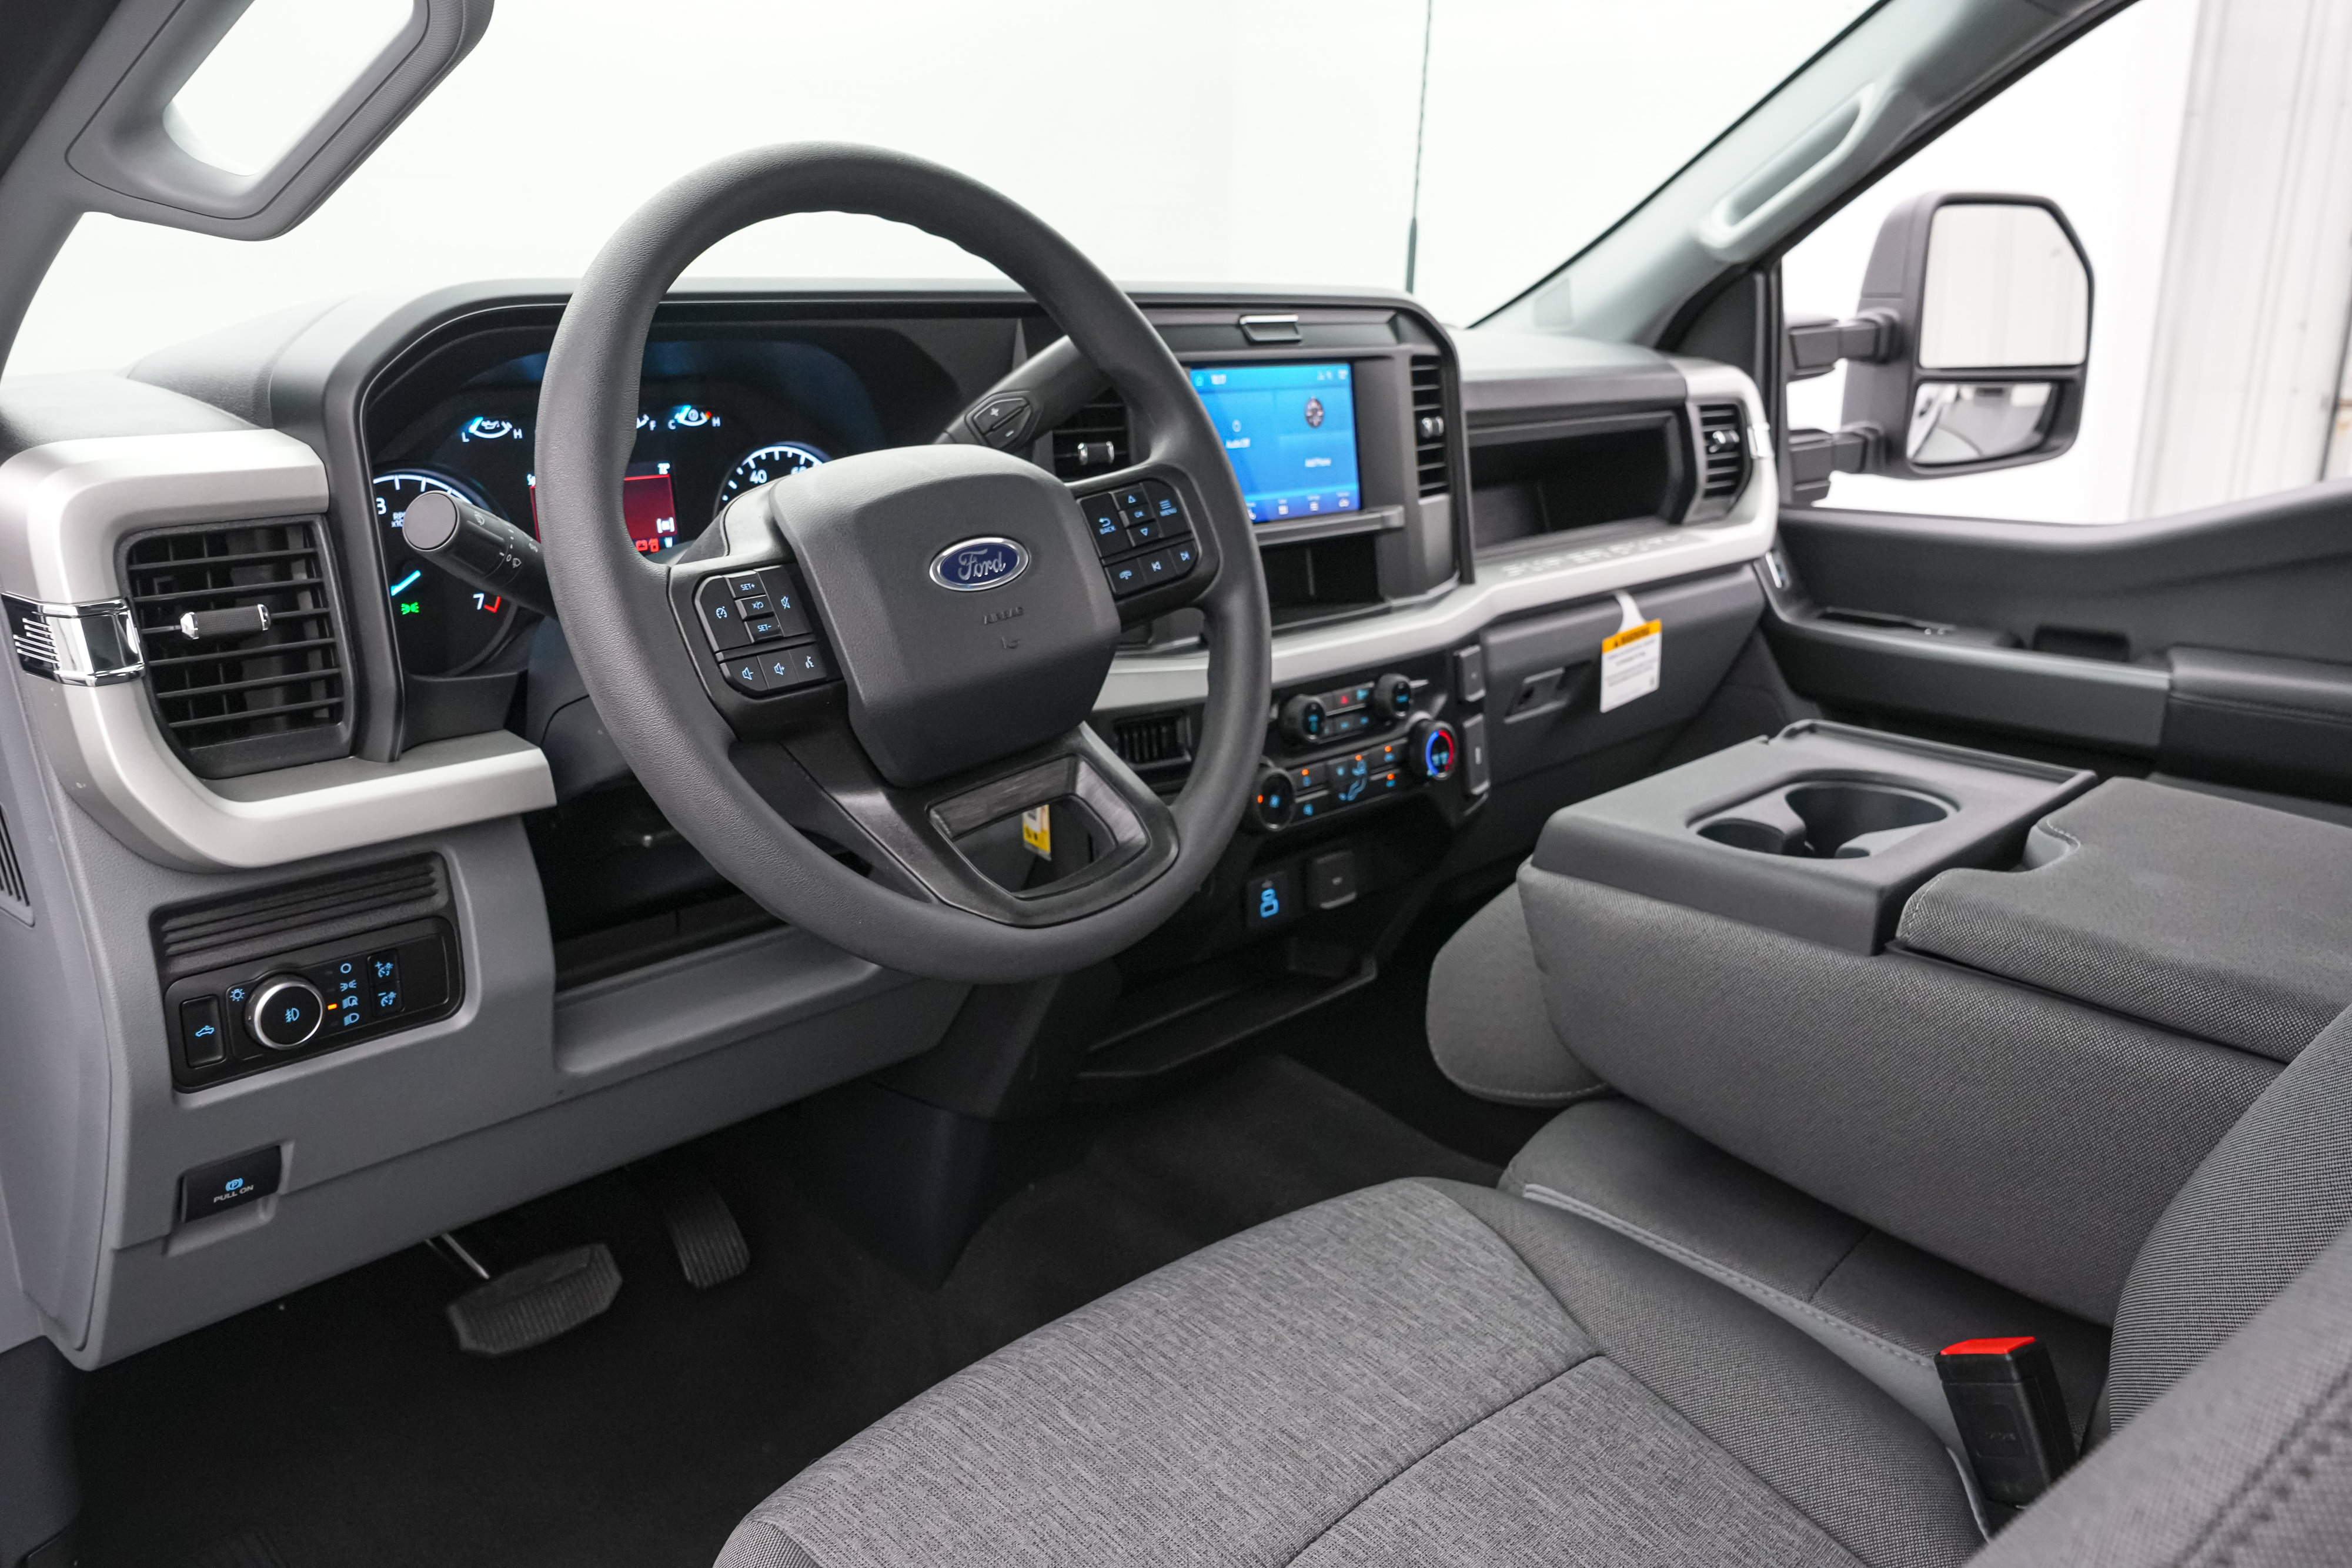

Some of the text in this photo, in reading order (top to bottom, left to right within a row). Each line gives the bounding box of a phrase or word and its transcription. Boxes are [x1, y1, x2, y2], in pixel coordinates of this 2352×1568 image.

[649, 420, 657, 431] F
[667, 416, 721, 430] C H
[461, 428, 523, 443] L H
[749, 469, 768, 484] 40
[376, 497, 387, 515] 3
[1159, 507, 1178, 517] MENU
[1098, 524, 1117, 536] BACK
[957, 548, 1007, 581] Ford
[740, 582, 756, 591] SET+
[472, 592, 485, 610] 7
[213, 1184, 254, 1203] PULL ON
